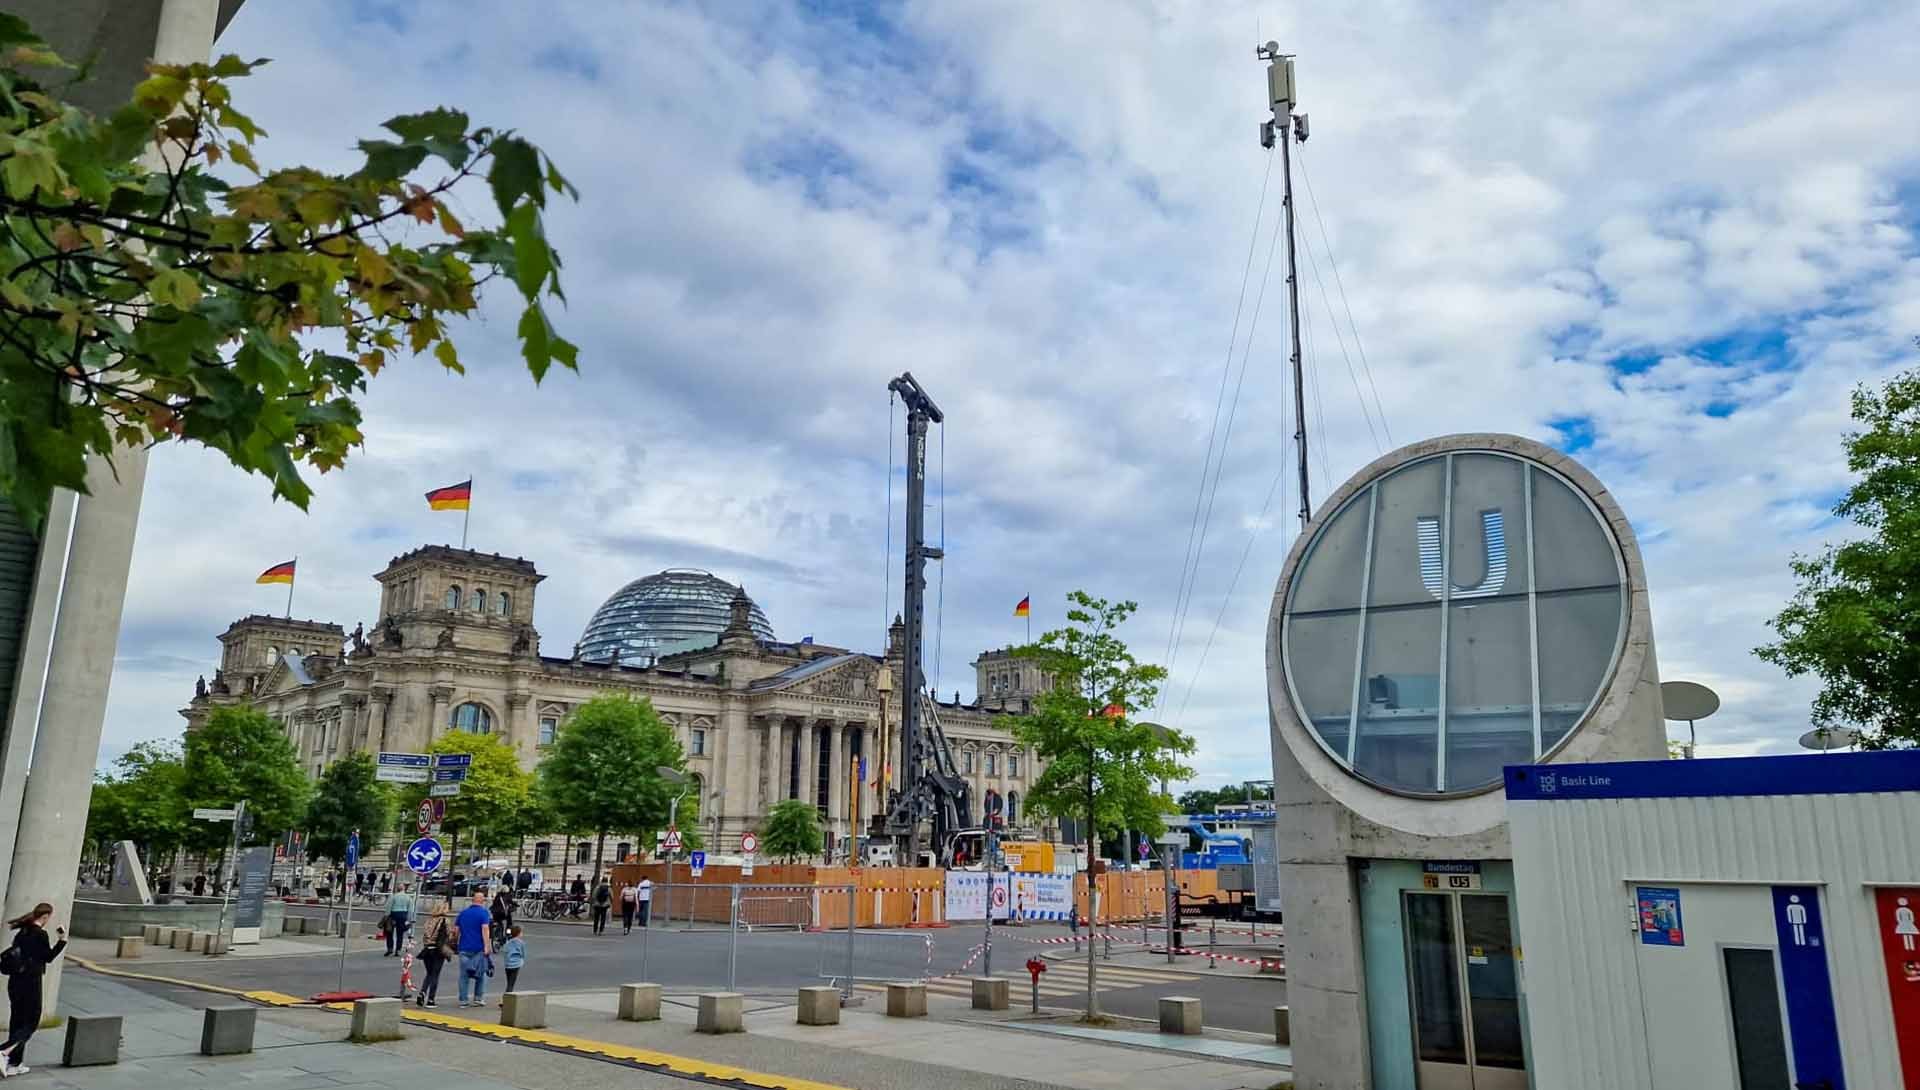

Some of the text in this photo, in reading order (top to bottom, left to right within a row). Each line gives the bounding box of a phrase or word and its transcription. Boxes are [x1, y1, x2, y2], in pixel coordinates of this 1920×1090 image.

[1416, 513, 1507, 609] U
[1561, 775, 1611, 785] Basic Line
[419, 808, 430, 824] 50
[1428, 863, 1474, 873] Bundestag
[1451, 877, 1468, 886] U5
